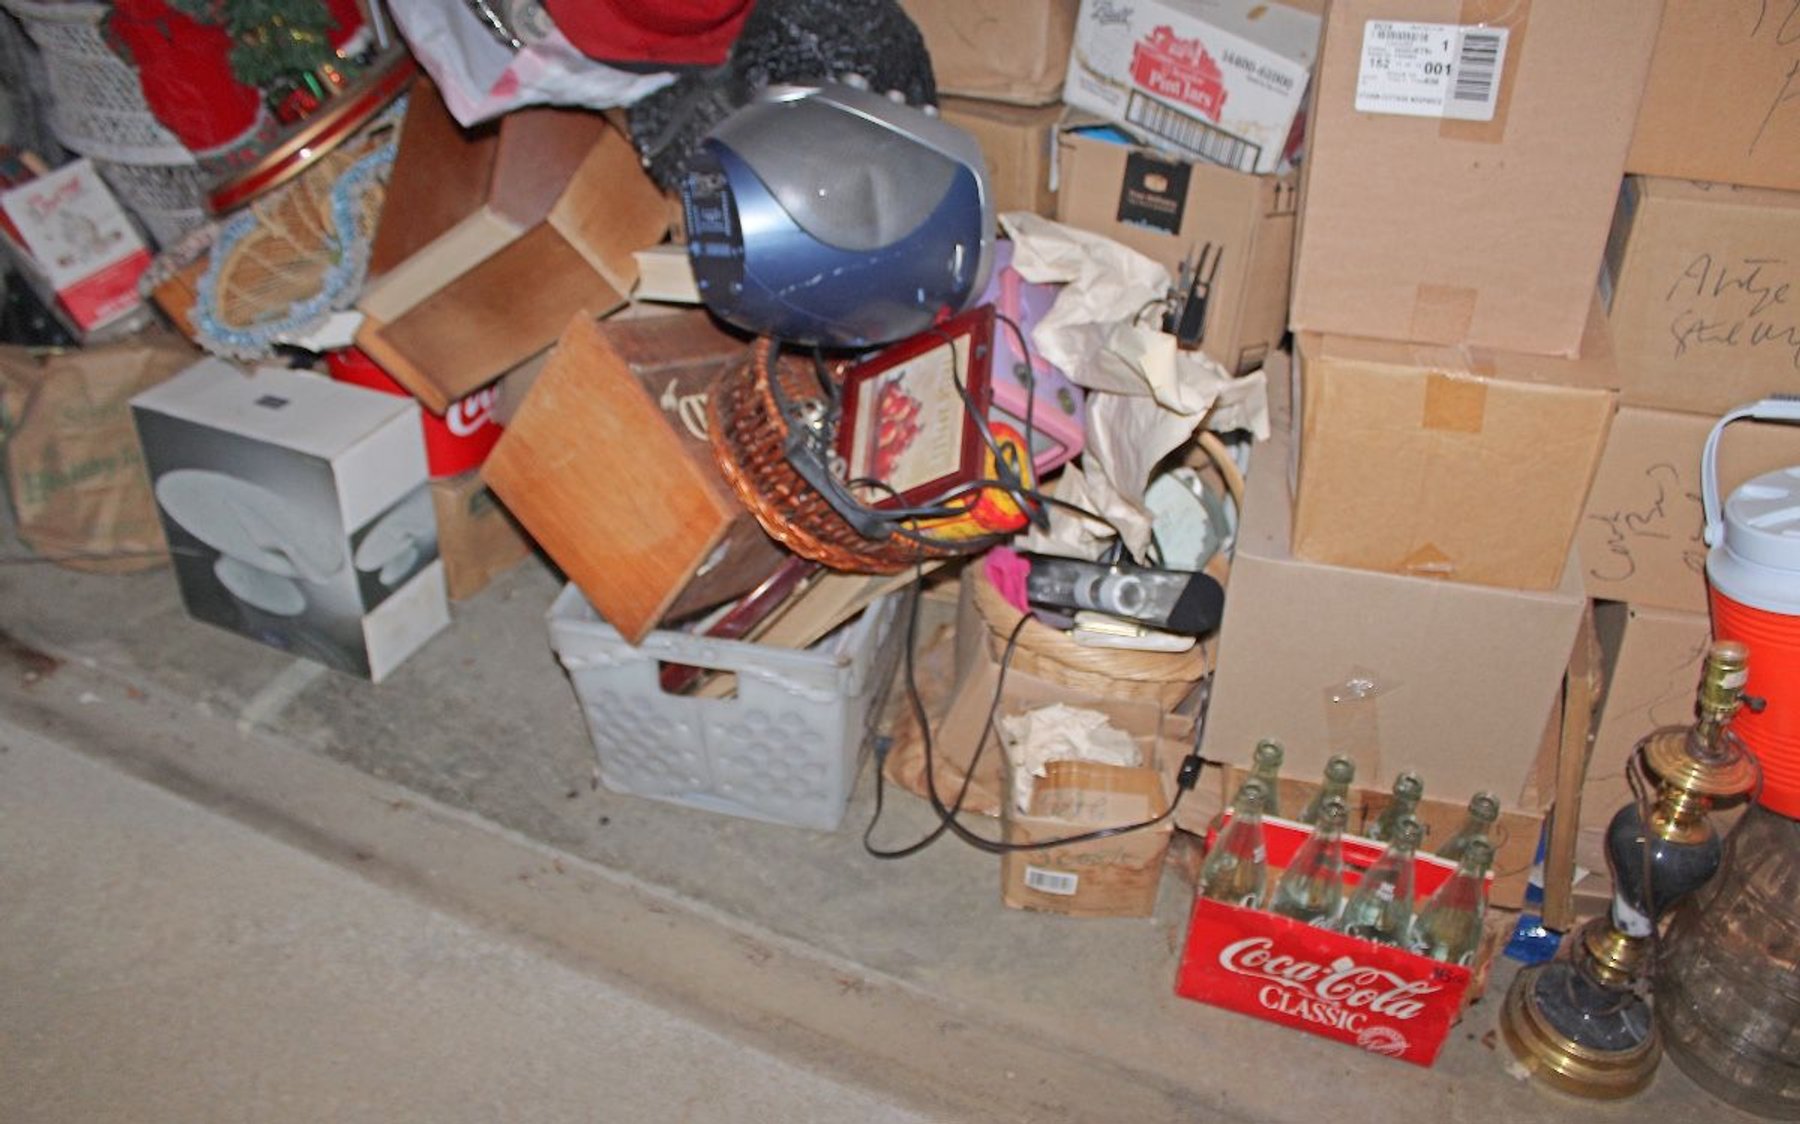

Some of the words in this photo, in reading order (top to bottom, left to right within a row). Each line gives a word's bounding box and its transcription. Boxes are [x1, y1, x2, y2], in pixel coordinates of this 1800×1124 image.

[1424, 62, 1452, 76] 001
[1219, 937, 1443, 1020] Coca-Cola
[1258, 984, 1368, 1034] CLASSIC
